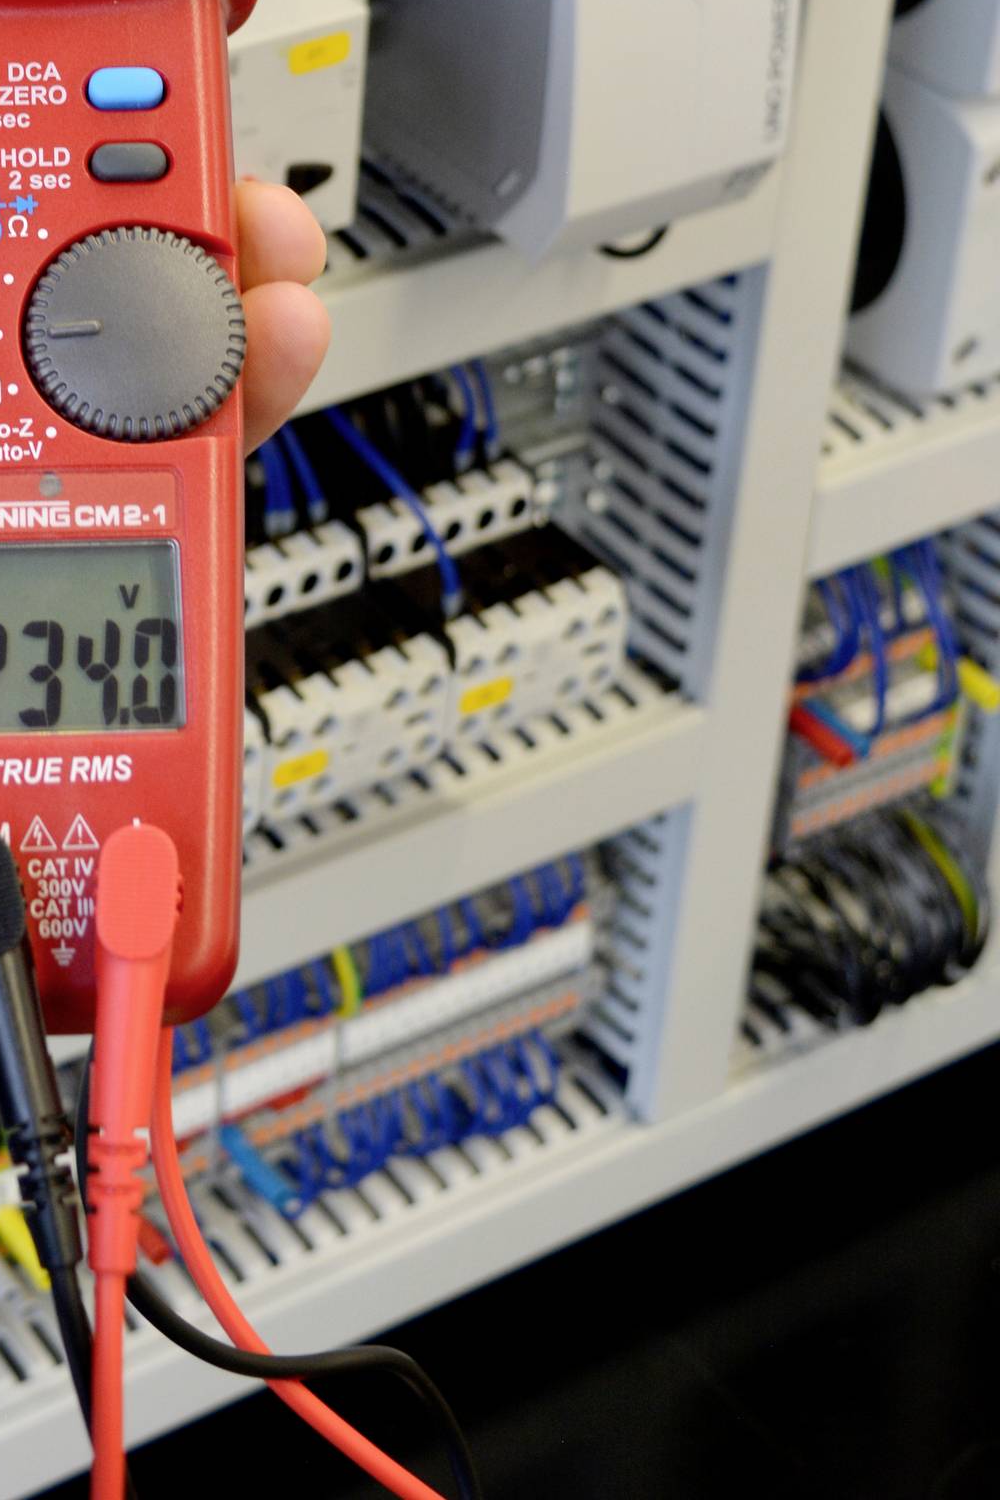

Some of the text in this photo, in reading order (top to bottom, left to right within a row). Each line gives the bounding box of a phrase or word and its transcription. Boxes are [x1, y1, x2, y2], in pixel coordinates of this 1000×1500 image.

[8, 61, 61, 82] DCA
[0, 147, 70, 168] HOLD
[9, 170, 22, 189] 2
[29, 173, 71, 189] sec
[8, 215, 28, 237] Ω
[119, 584, 140, 609] V
[70, 755, 132, 782] RMS
[27, 856, 94, 879] CAT IV
[38, 878, 85, 898] 300V
[30, 898, 94, 919] CAT III
[39, 918, 88, 939] 600V
